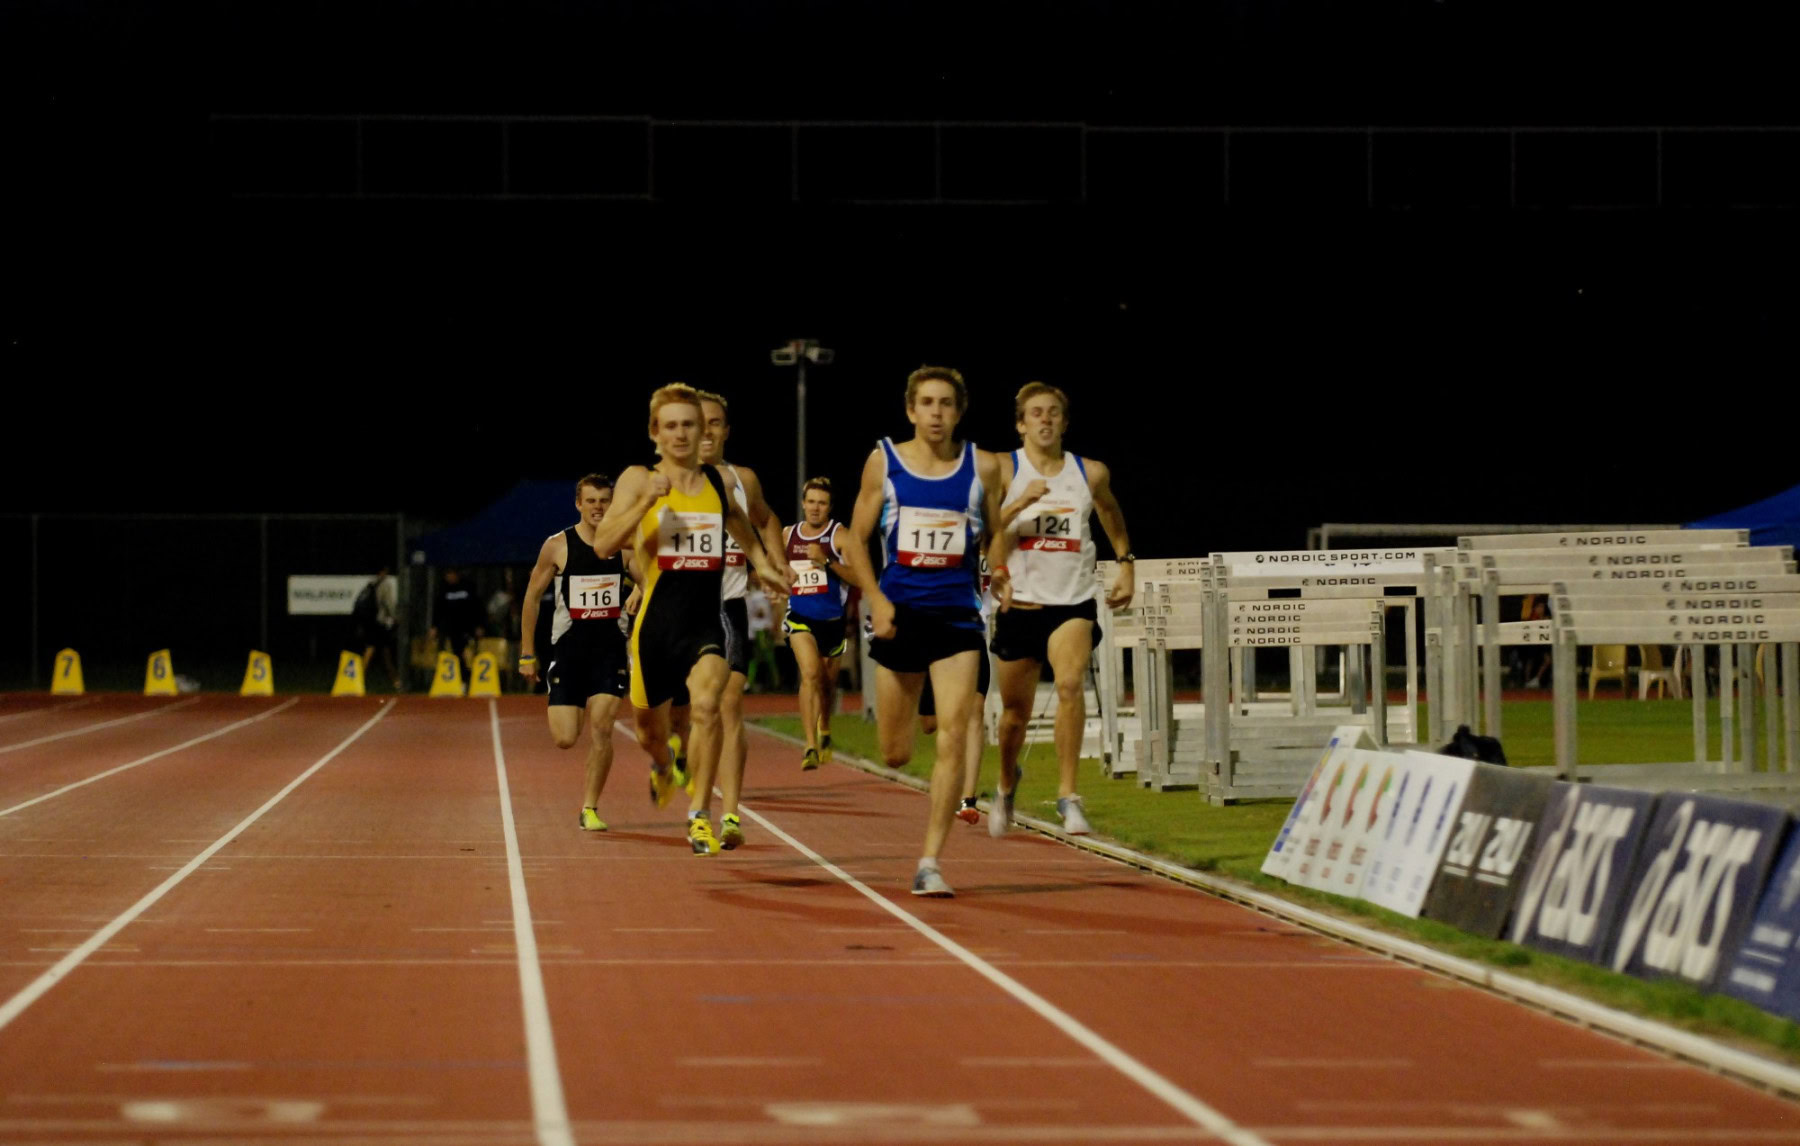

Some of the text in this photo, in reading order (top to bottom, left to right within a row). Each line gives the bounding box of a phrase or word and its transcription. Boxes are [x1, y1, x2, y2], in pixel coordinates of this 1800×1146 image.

[1033, 515, 1070, 535] 124
[671, 533, 712, 553] 118
[911, 529, 954, 550] 117
[1577, 536, 1646, 545] NORDIC
[1607, 554, 1682, 565] NORDIC
[1316, 578, 1376, 586] NORDIC
[1611, 569, 1686, 579] NORDIC
[1680, 580, 1757, 591] NORDIC
[580, 590, 611, 606] 116
[1685, 599, 1762, 609] NORDIC
[1688, 615, 1764, 624] NORDIC
[1692, 630, 1769, 640] NORDIC
[63, 655, 73, 679] 7
[153, 655, 166, 680] 6
[253, 657, 266, 681] 5
[344, 658, 356, 679] 4
[442, 659, 455, 682] 3
[479, 659, 491, 682] 2
